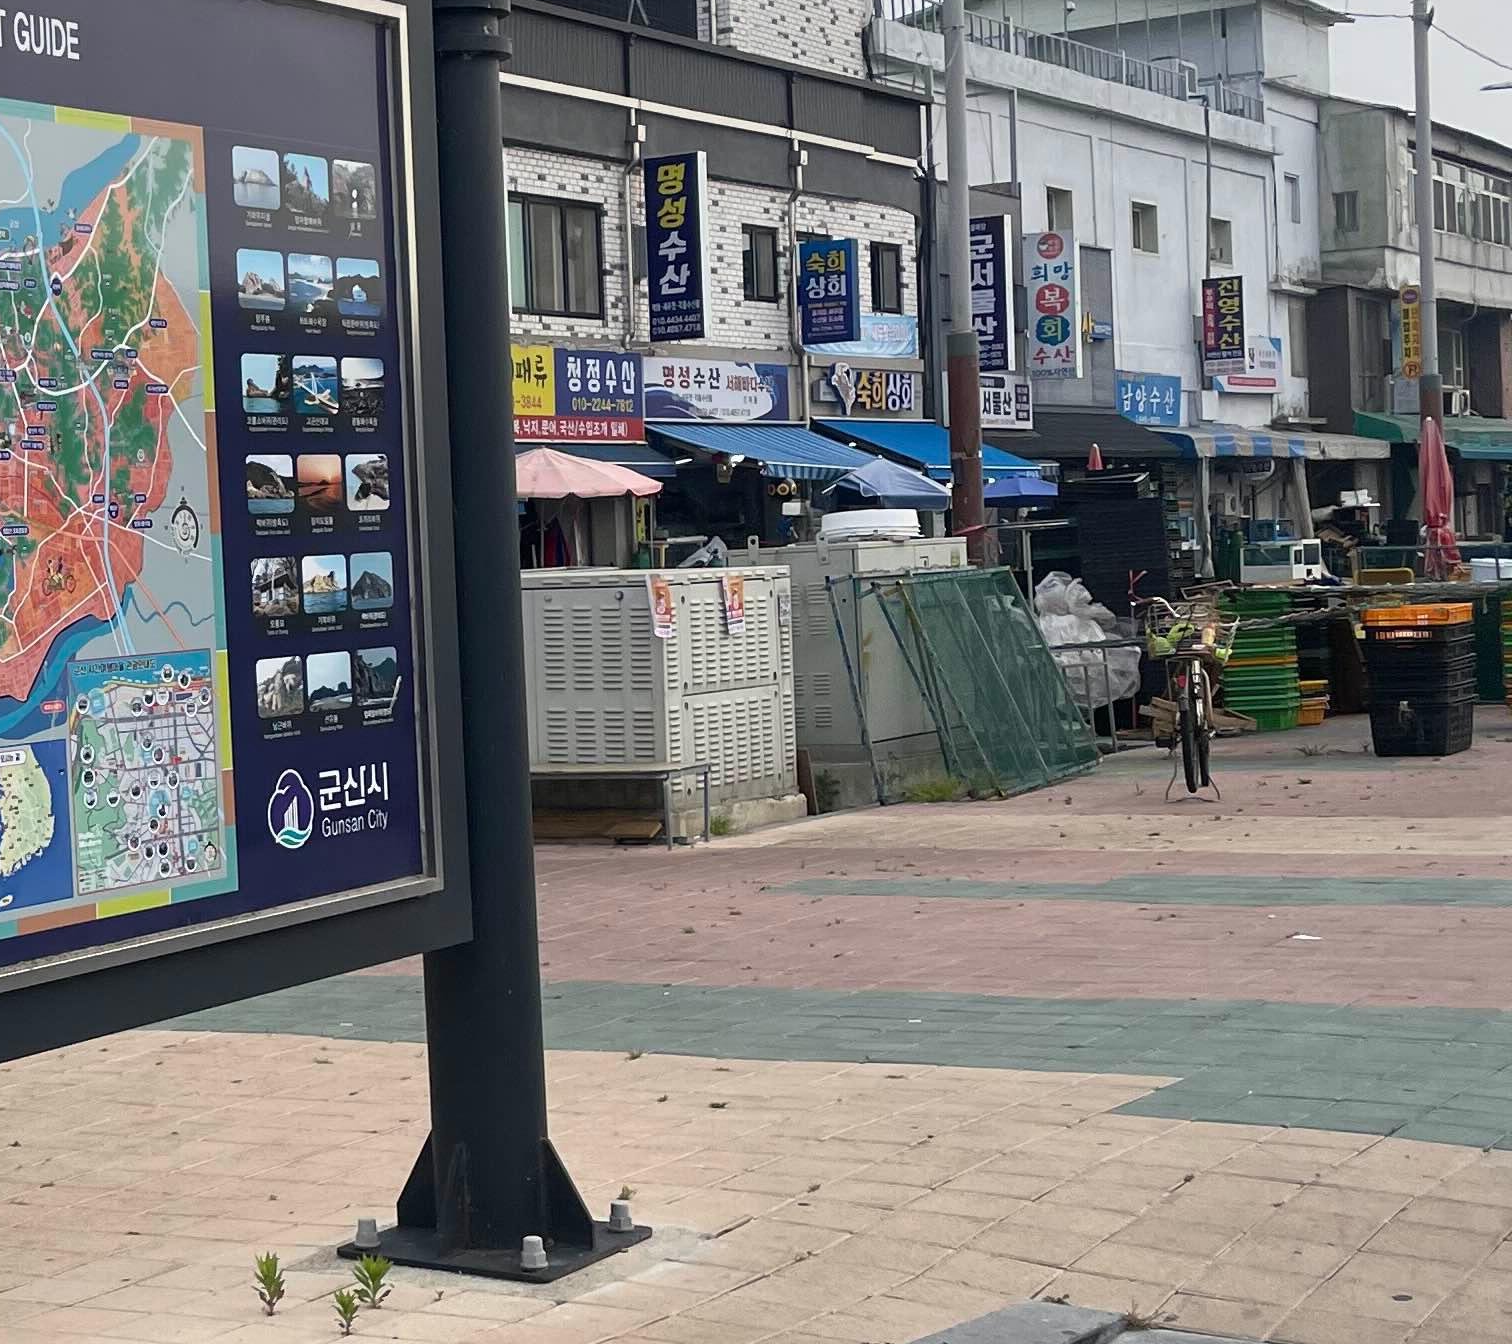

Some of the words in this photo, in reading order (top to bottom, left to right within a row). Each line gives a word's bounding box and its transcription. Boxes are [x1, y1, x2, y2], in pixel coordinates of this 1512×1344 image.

[14, 10, 81, 61] GUIDE
[657, 162, 690, 295] 명성수산
[806, 250, 846, 273] 숙희
[1031, 261, 1073, 282] 희망
[806, 275, 847, 299] 상회
[1218, 278, 1242, 350] 진영수산
[1033, 346, 1074, 365] 수산
[567, 356, 635, 395] 청정수산
[662, 365, 720, 390] 명성수산
[856, 371, 916, 412] 숙희상회
[1121, 383, 1175, 415] 남양수산
[319, 762, 389, 811] 군산시
[321, 815, 365, 838] Gunsan
[368, 809, 389, 830] City
